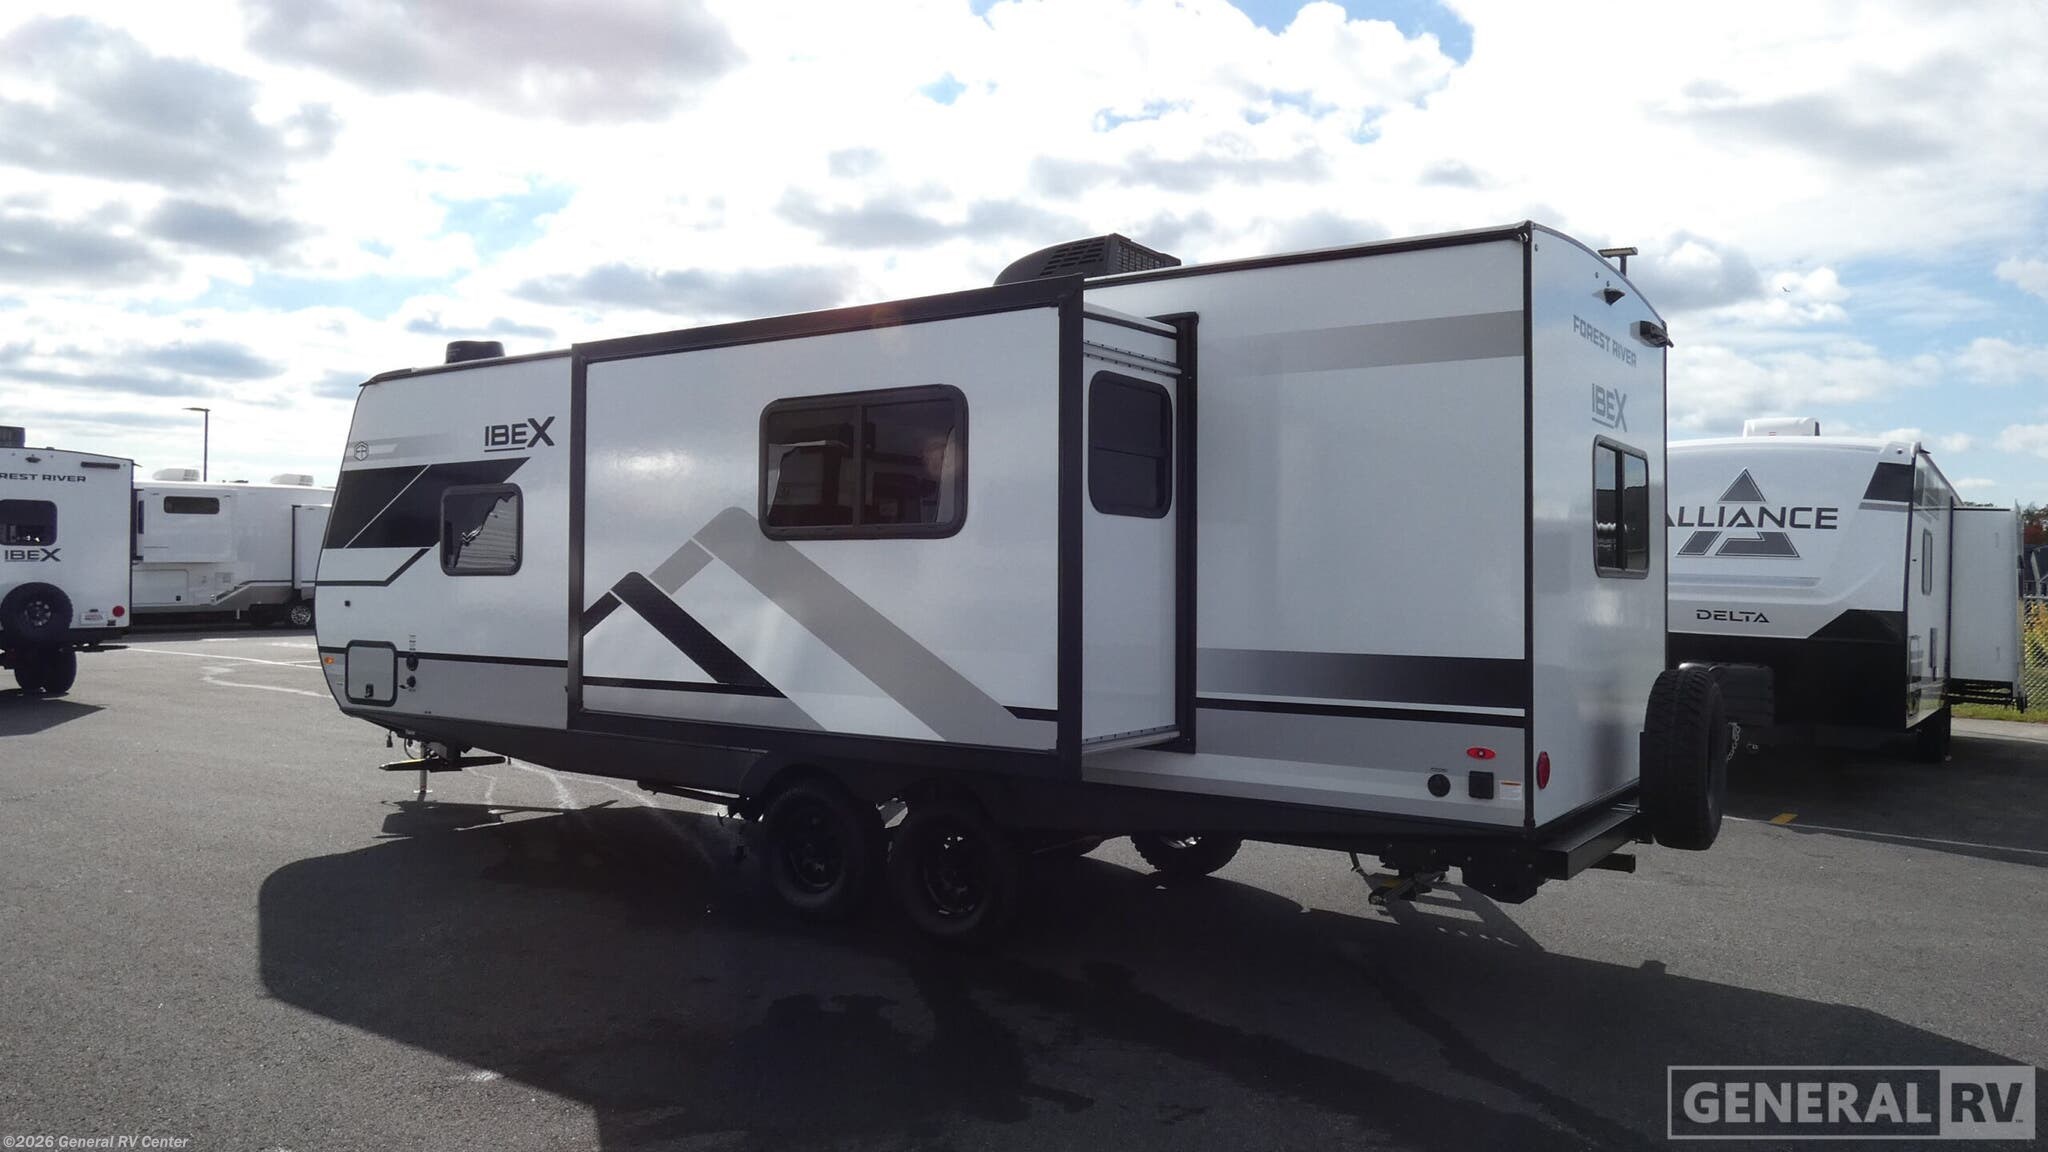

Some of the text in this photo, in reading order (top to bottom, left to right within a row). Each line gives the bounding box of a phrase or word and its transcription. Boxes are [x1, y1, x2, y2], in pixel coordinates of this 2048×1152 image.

[1573, 314, 1637, 368] FOREST RIVER
[1592, 383, 1627, 432] IBEX
[484, 416, 555, 448] IBEX
[42, 474, 87, 482] RIVER
[5, 548, 61, 562] IBEX
[1696, 609, 1770, 623] DELTA
